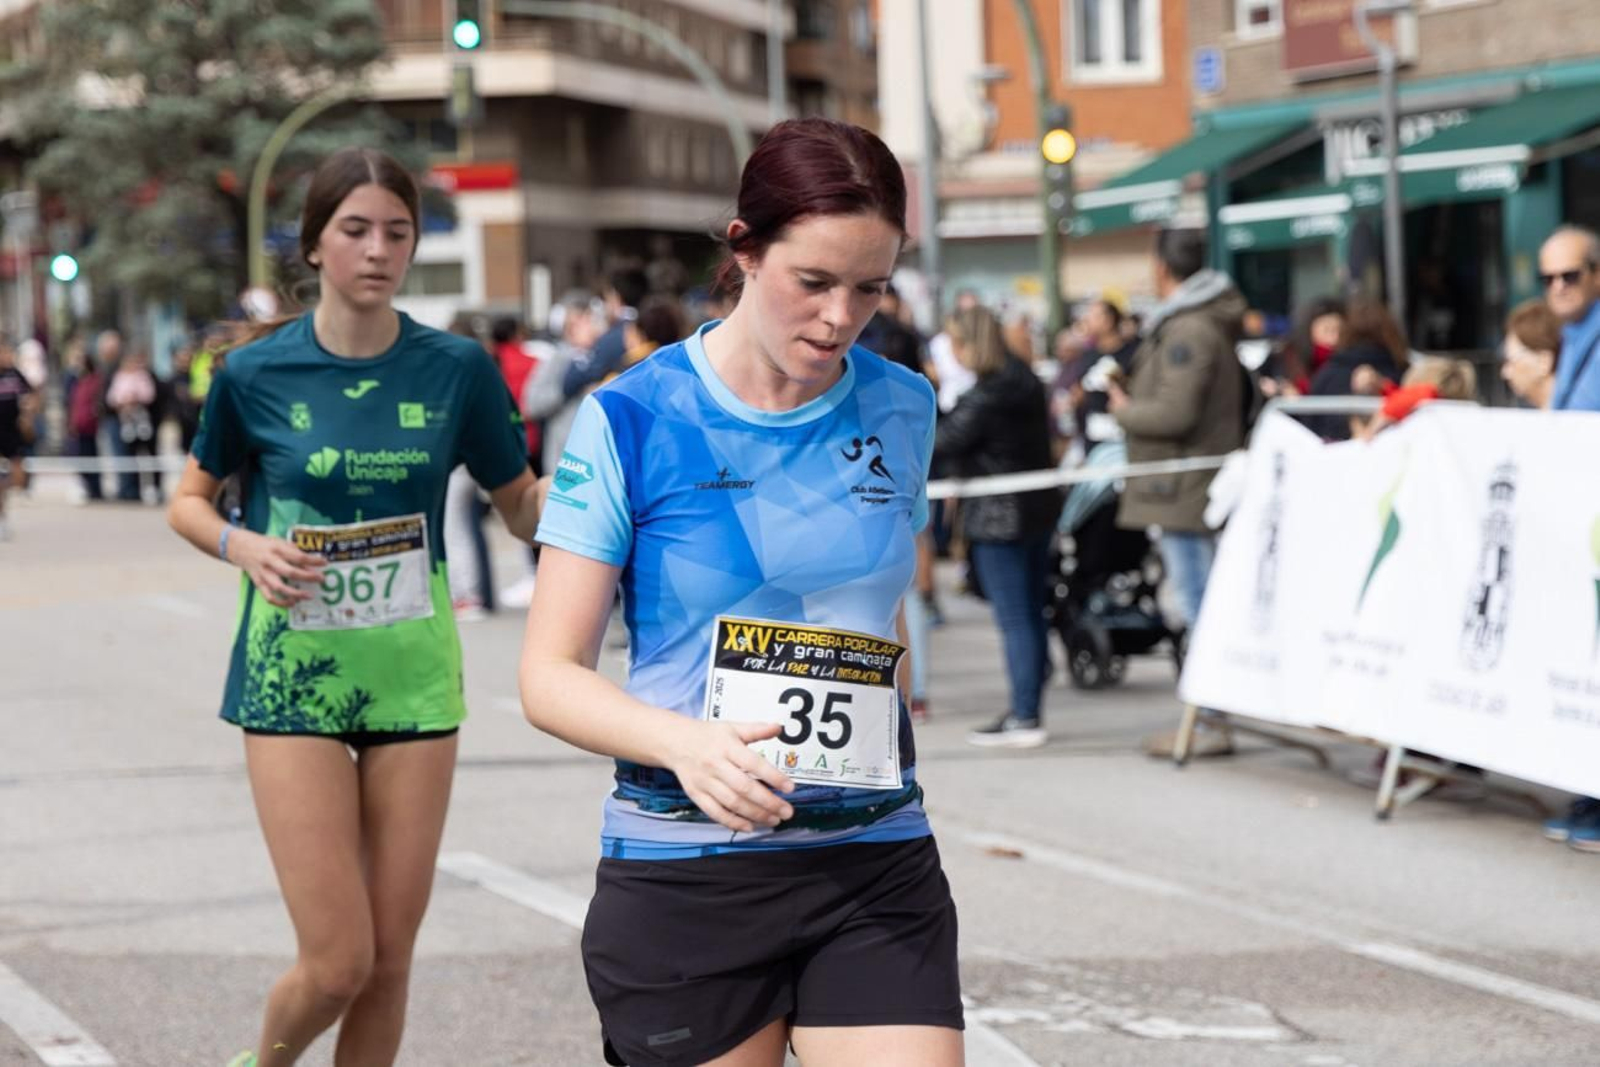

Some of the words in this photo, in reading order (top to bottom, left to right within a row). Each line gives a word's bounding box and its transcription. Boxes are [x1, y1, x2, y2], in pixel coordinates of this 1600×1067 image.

[344, 447, 430, 466] Fundación
[345, 464, 408, 484] Unicaja
[321, 561, 401, 606] 967
[723, 623, 773, 654] XXV
[775, 629, 843, 650] CARRERA
[843, 636, 899, 657] POPULAR
[742, 657, 768, 671] POR
[767, 660, 787, 673] LA
[786, 661, 810, 675] PAZ
[820, 666, 836, 678] LA
[774, 643, 785, 657] y
[794, 645, 835, 660] gran
[841, 650, 893, 668] caminata
[777, 687, 853, 750] 35
